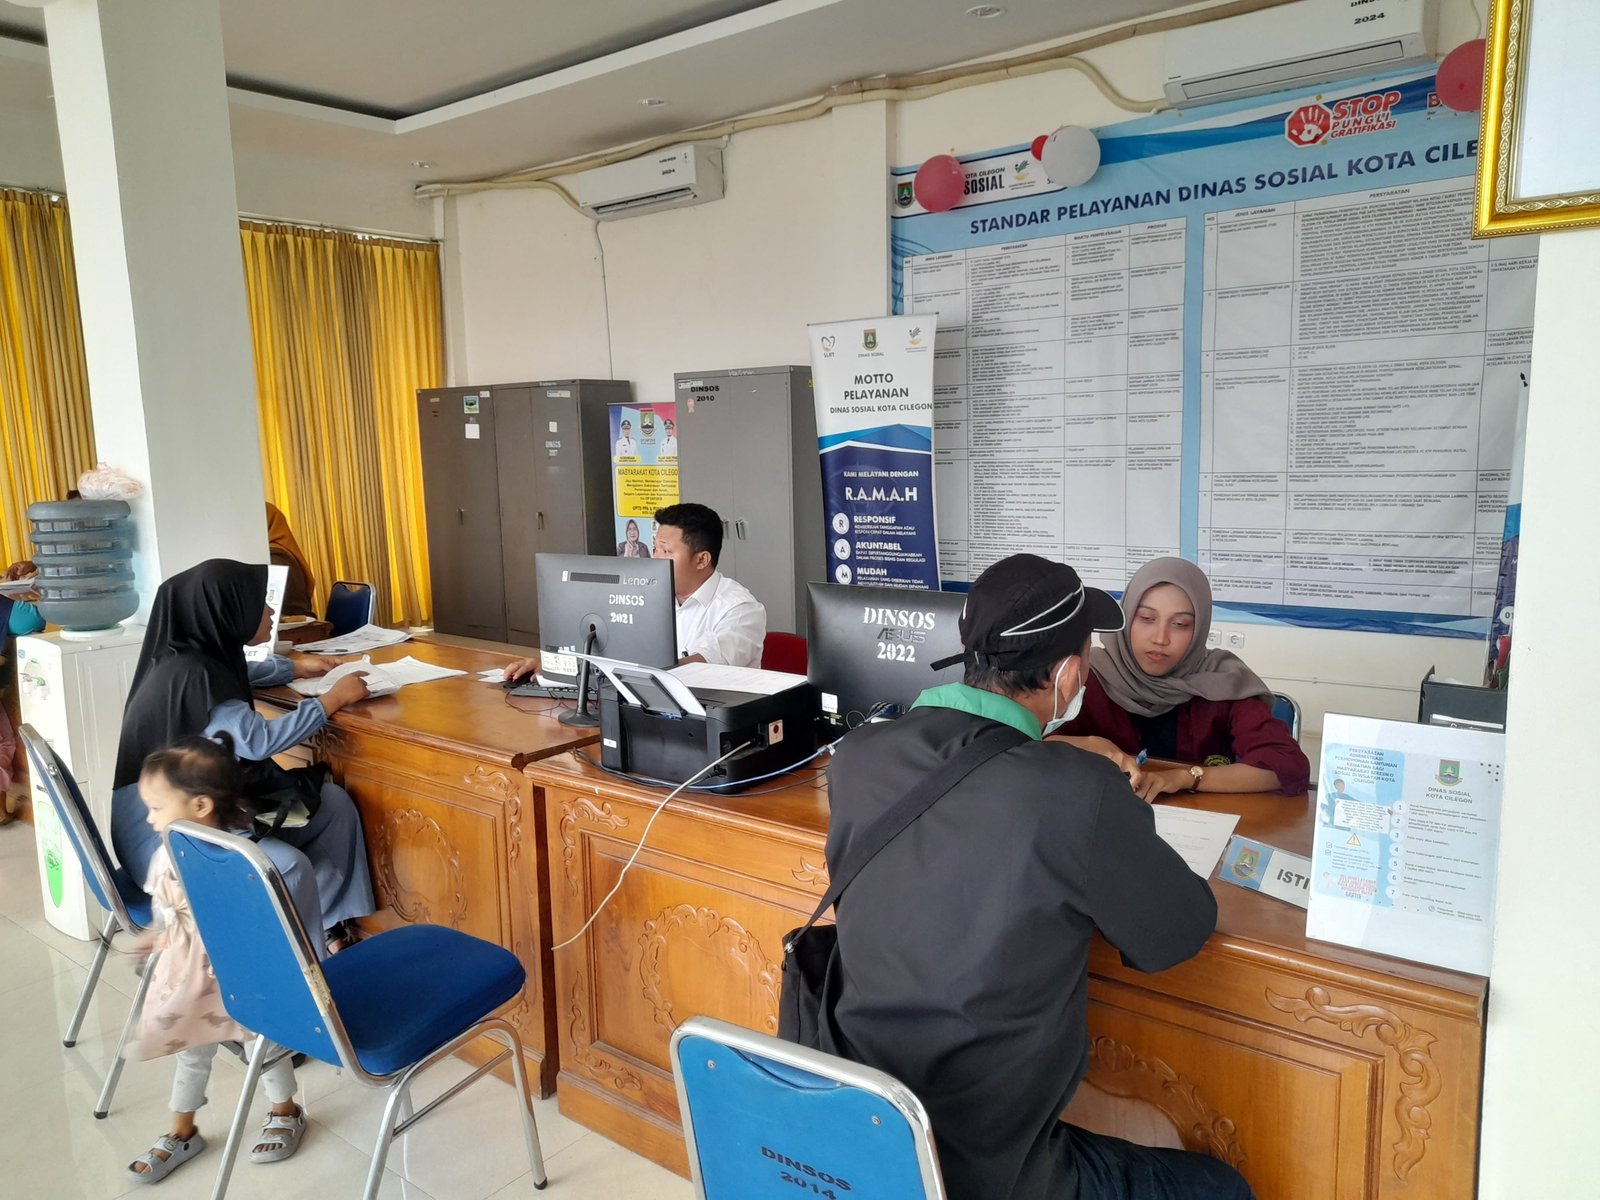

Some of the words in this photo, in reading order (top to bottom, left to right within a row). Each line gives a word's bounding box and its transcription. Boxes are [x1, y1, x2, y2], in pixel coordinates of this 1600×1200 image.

[1353, 12, 1385, 24] 2024
[1333, 90, 1402, 121] STOP
[1331, 111, 1391, 129] PUNGLI
[1330, 120, 1397, 139] GRATIFIKASI
[978, 167, 1006, 177] CILEGON
[963, 174, 1005, 196] SOSIAL
[970, 209, 1050, 235] STANDAR
[1057, 189, 1171, 221] PELAYANAN
[1178, 177, 1247, 202] DINAS
[1254, 163, 1338, 191] SOSIAL
[1347, 150, 1416, 177] KOTA
[1425, 138, 1478, 164] CILE
[854, 373, 894, 385] MOTTO
[690, 385, 720, 393] DINSOS
[844, 387, 909, 400] PELAYANAN
[830, 406, 850, 414] DINAS
[851, 405, 876, 413] SOSIAL
[877, 404, 897, 412] KOTA
[899, 403, 933, 411] CILEGON
[889, 470, 919, 478] DENGAN
[845, 486, 918, 502] R.A.M.A.H
[838, 520, 844, 528] R
[853, 515, 896, 524] RESPONSIF
[840, 546, 846, 554] A
[855, 541, 902, 551] AKUNTABEL
[841, 571, 848, 579] M
[857, 567, 887, 576] MUDAH
[623, 576, 658, 587] Lenovo
[609, 594, 645, 607] DINSOS
[610, 612, 634, 625] 2021
[863, 606, 936, 630] DINSOS
[877, 642, 916, 663] 2022
[1445, 795, 1473, 804] CILEGON
[1449, 789, 1472, 797] SOSIAL
[761, 1146, 852, 1191] DINSOS
[780, 1171, 837, 1200] 2014
